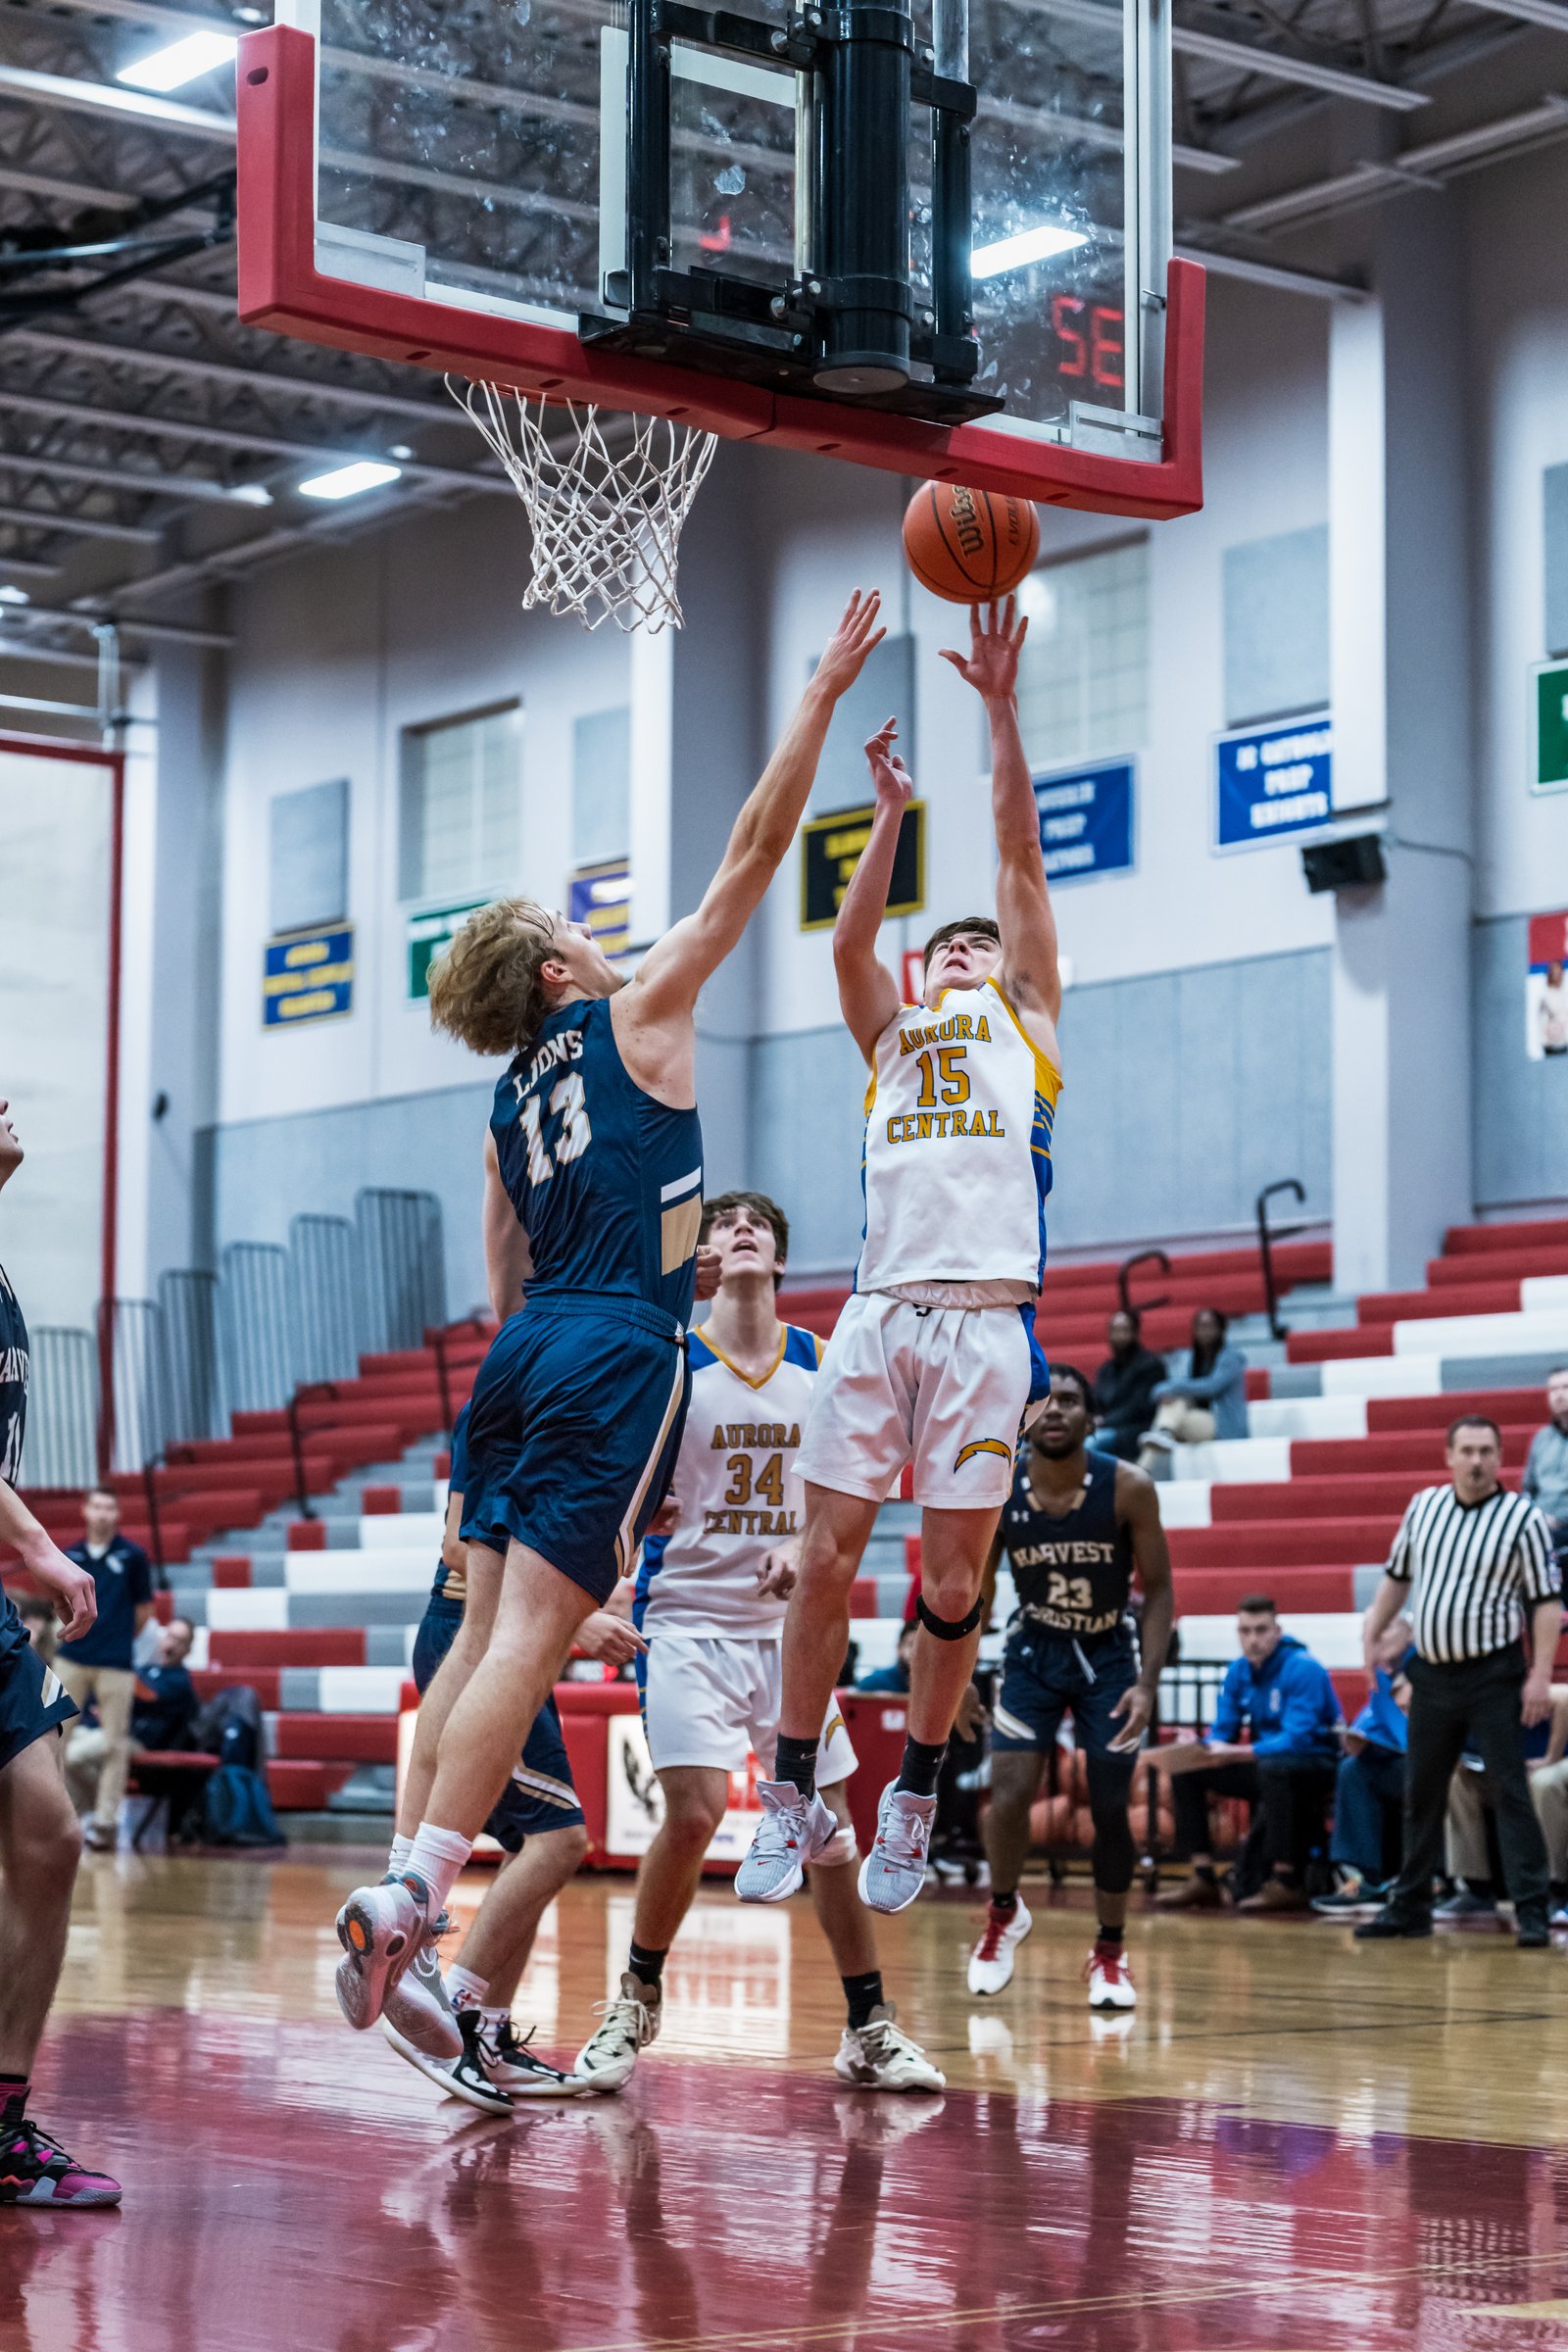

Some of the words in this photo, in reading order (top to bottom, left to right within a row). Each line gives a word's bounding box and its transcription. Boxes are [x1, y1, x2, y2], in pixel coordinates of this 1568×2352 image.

[899, 1014, 992, 1056] AURORA
[513, 1029, 584, 1105] LIONS
[915, 1046, 970, 1107] 15
[519, 1071, 592, 1188] 13
[887, 1109, 1005, 1144] CENTRAL
[710, 1423, 801, 1449] AURORA
[724, 1453, 784, 1506] 34
[1012, 1541, 1114, 1568] HARVEST
[1047, 1571, 1093, 1610] 23
